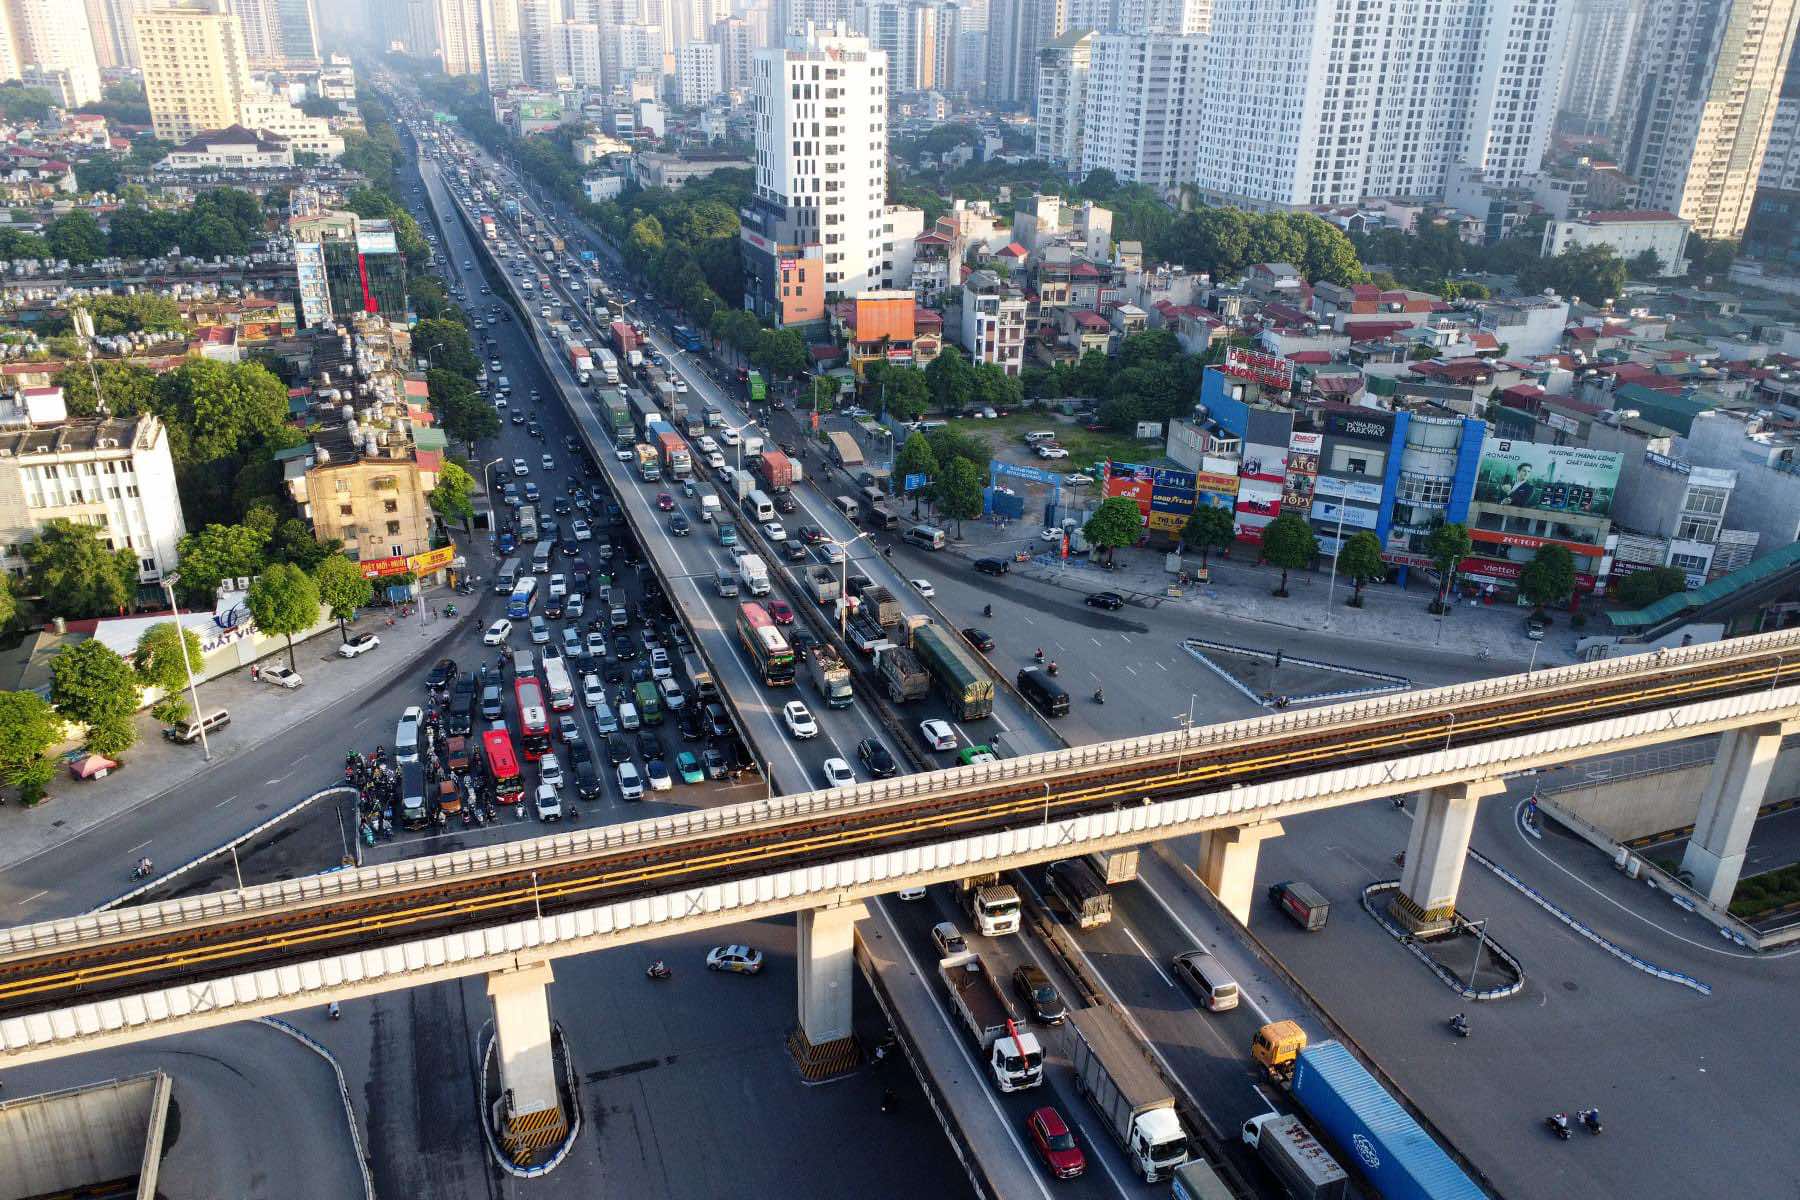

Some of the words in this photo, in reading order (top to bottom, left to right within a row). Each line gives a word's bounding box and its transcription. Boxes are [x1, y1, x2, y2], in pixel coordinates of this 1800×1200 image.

[1346, 422, 1385, 437] PARKWAY
[1153, 495, 1193, 505] GOODYEAR
[369, 535, 384, 545] C3
[1484, 564, 1515, 576] viettel
